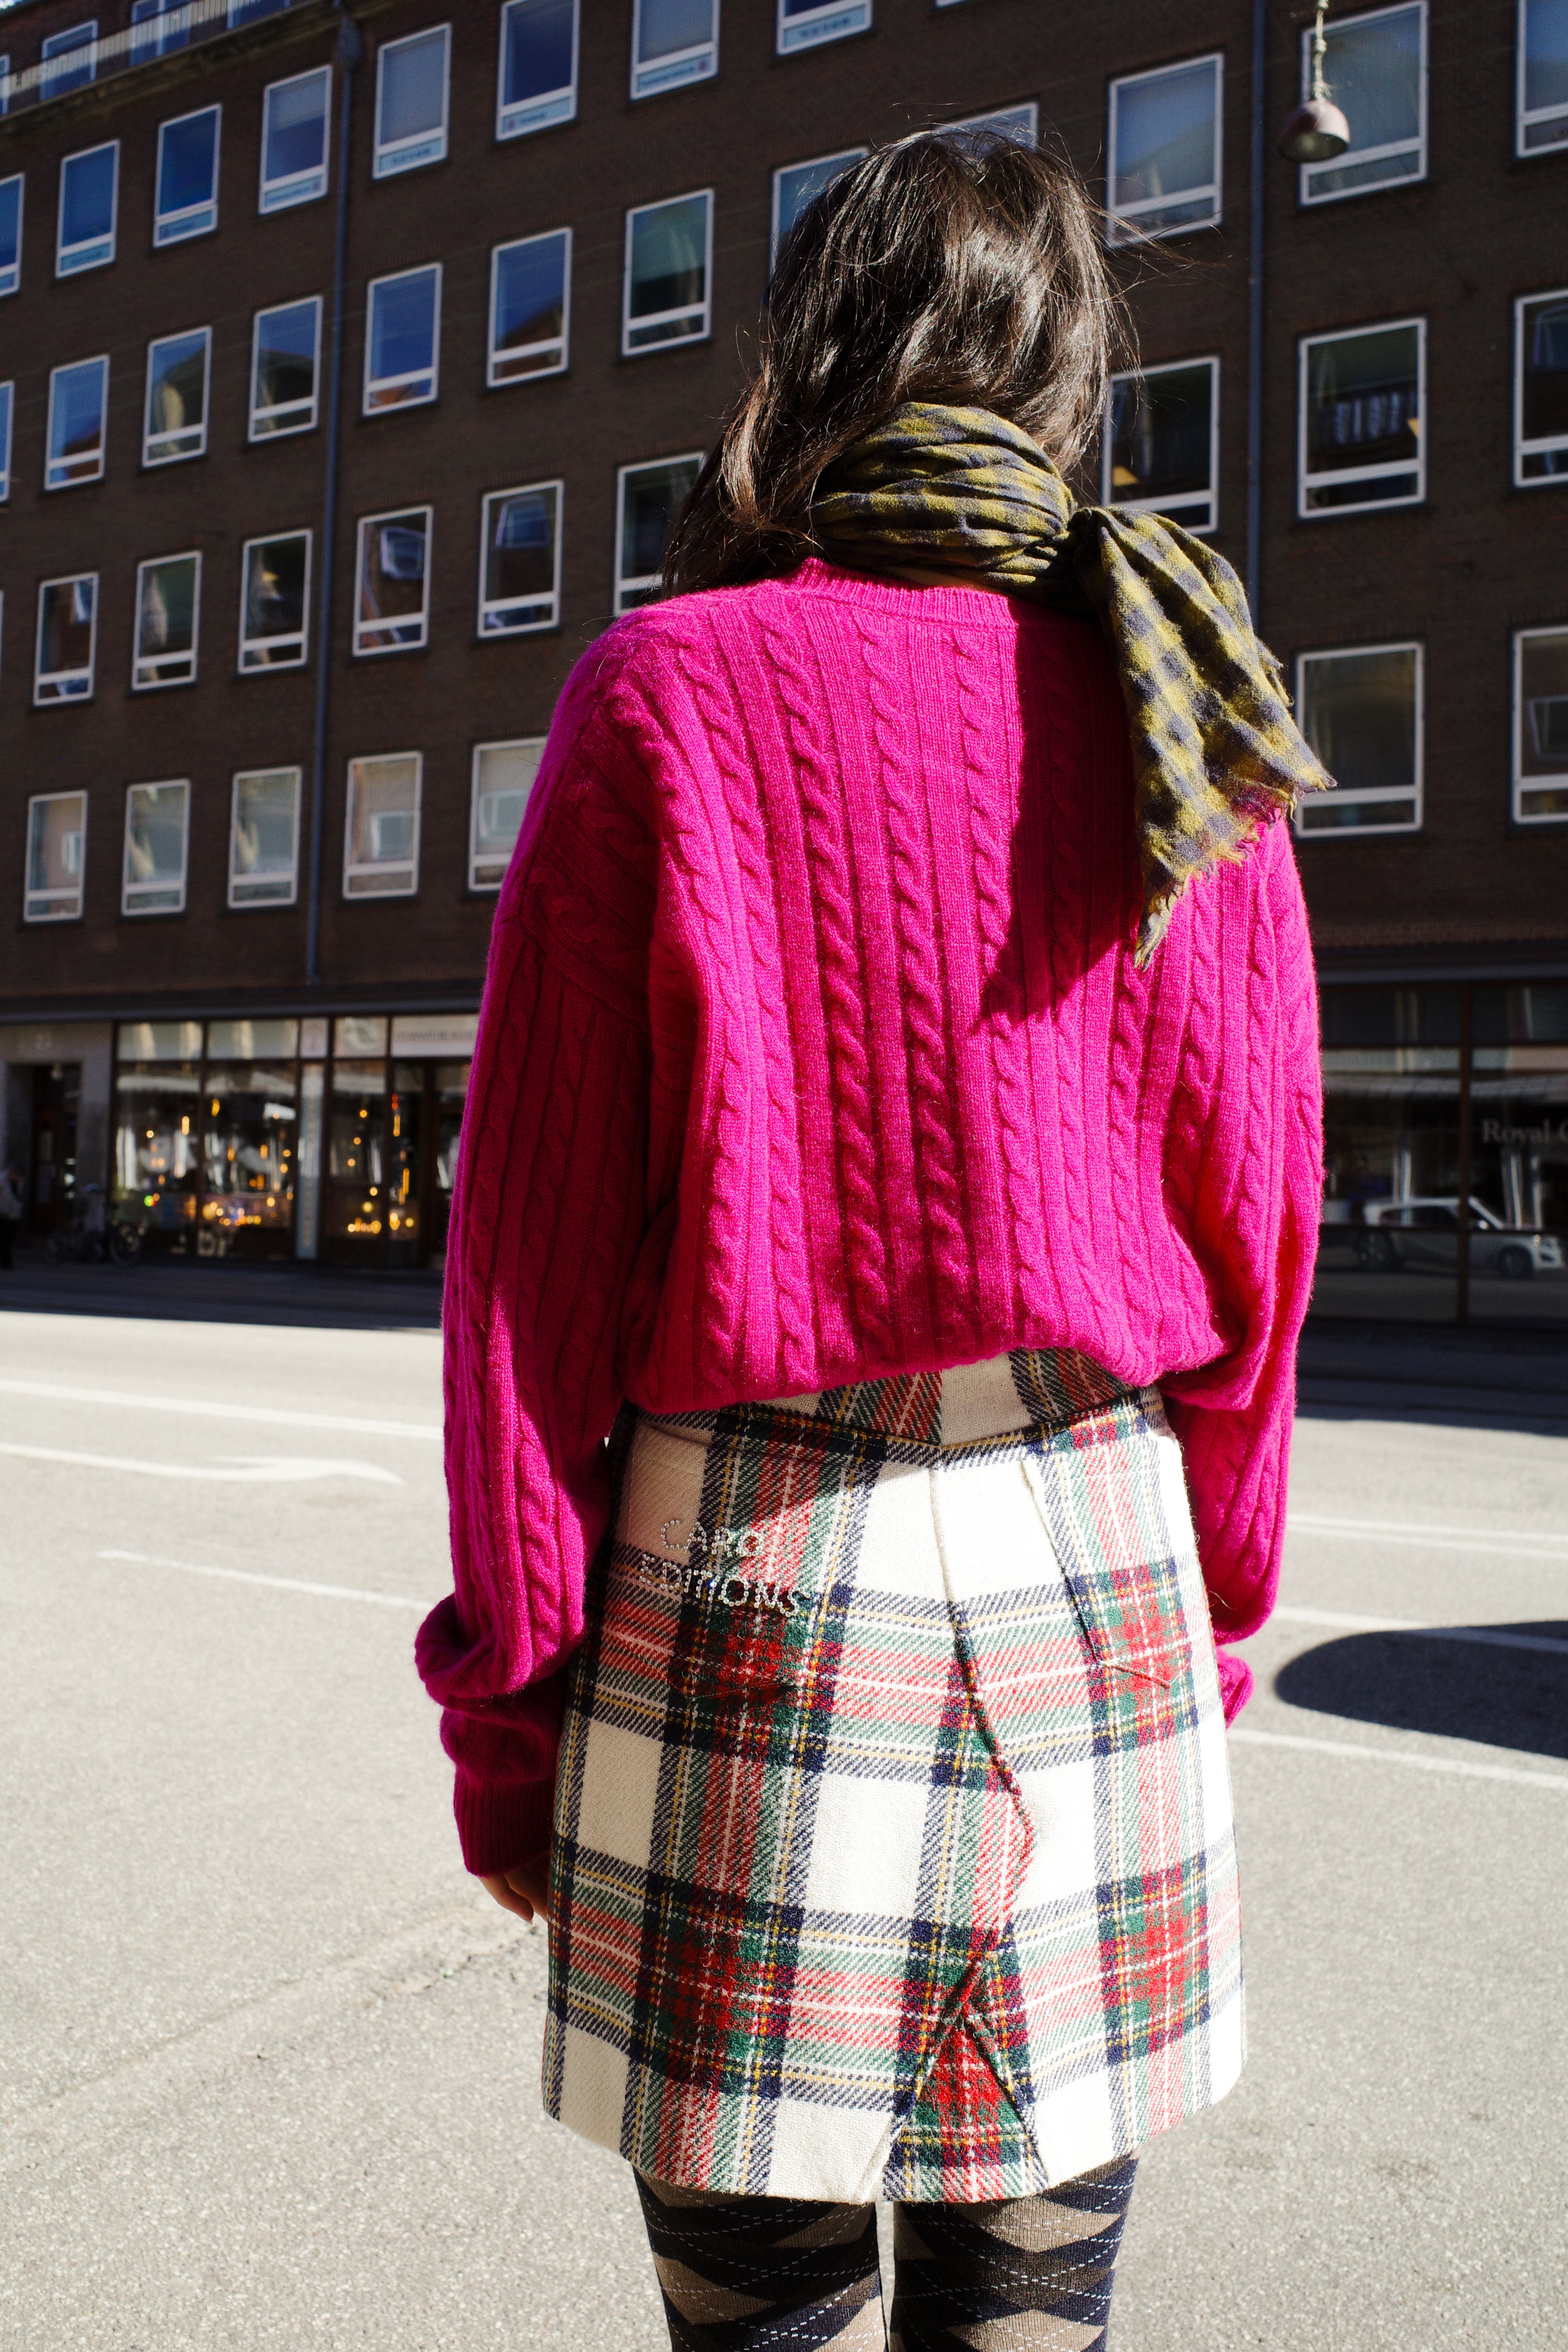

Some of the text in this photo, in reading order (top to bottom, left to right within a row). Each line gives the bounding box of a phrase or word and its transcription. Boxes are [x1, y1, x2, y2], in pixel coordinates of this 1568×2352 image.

[1482, 1118, 1551, 1145] Royal
[660, 1519, 764, 1558] CARO
[638, 1554, 811, 1618] EDITIONS
